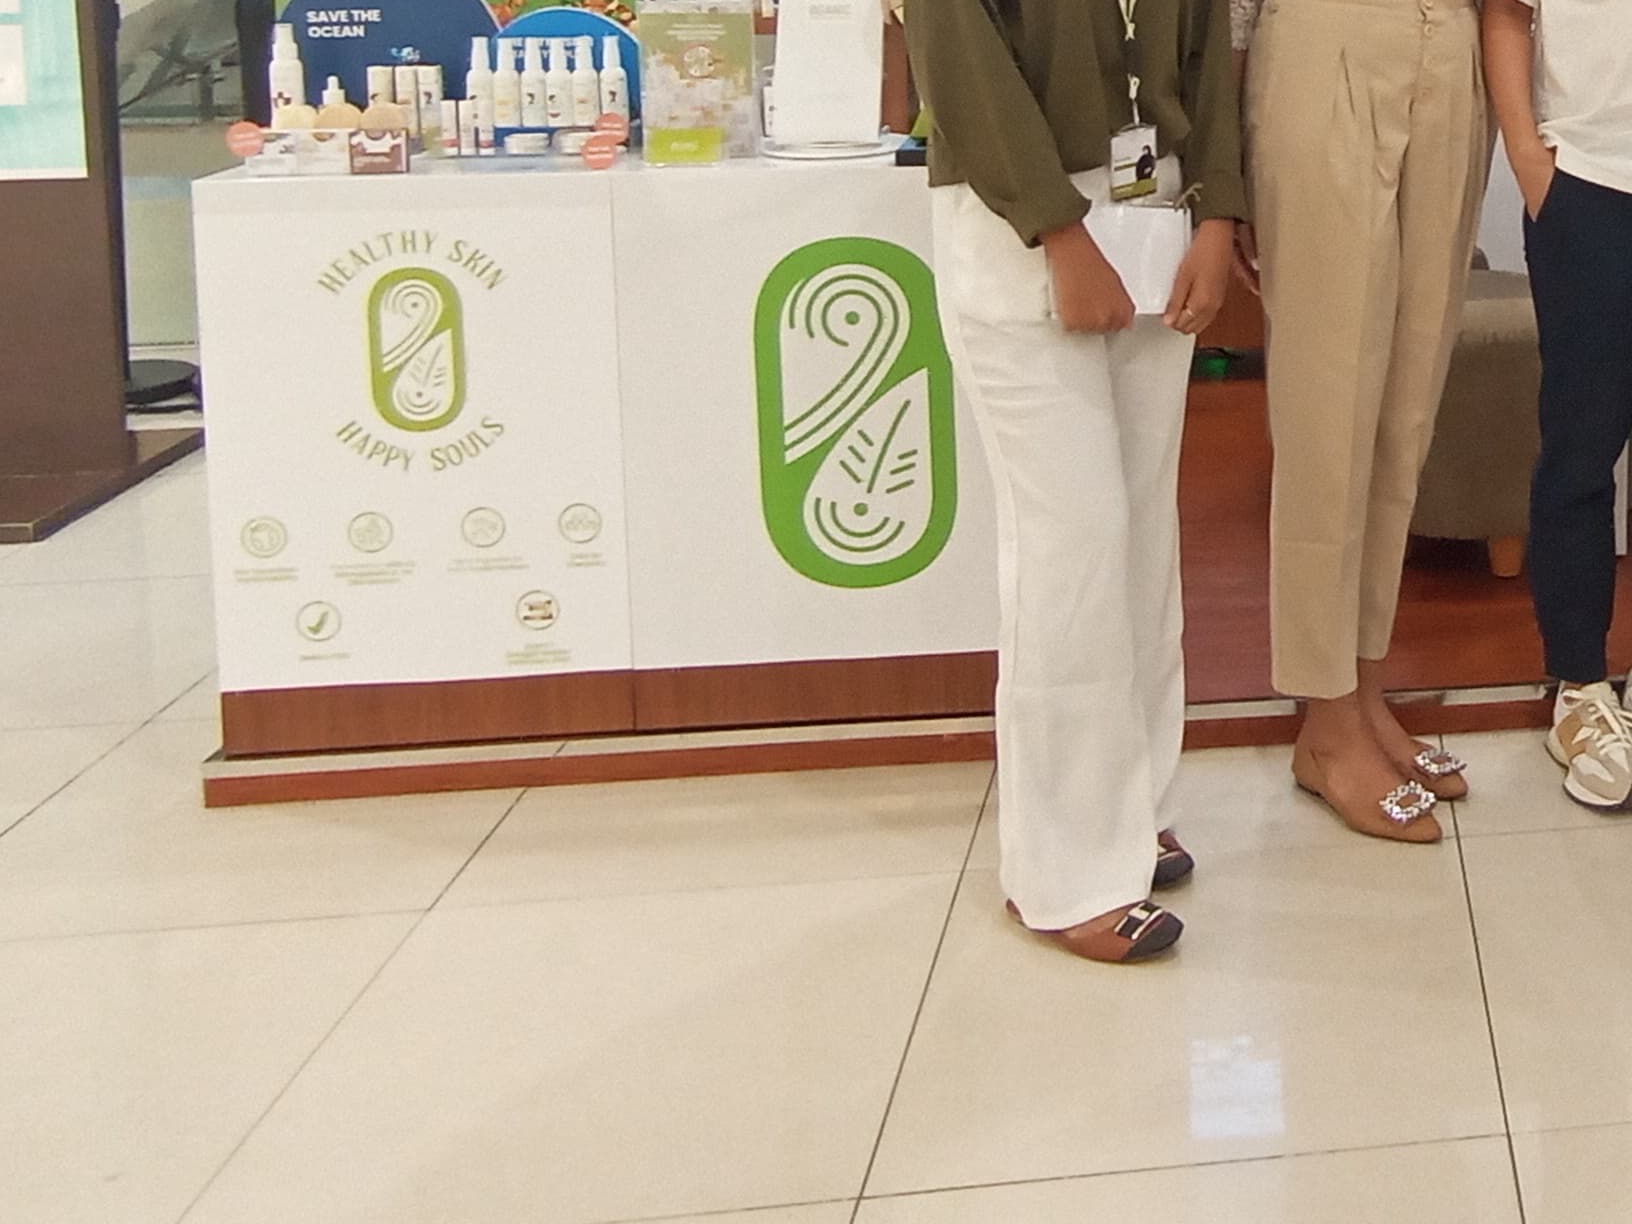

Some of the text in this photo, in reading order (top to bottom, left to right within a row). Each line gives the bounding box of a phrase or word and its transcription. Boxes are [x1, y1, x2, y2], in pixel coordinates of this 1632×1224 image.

[306, 9, 382, 24] SAVE THE
[308, 25, 365, 39] OCEAN
[317, 229, 507, 295] HEALTHY SKIN
[335, 415, 505, 472] HAPPY SOULS
